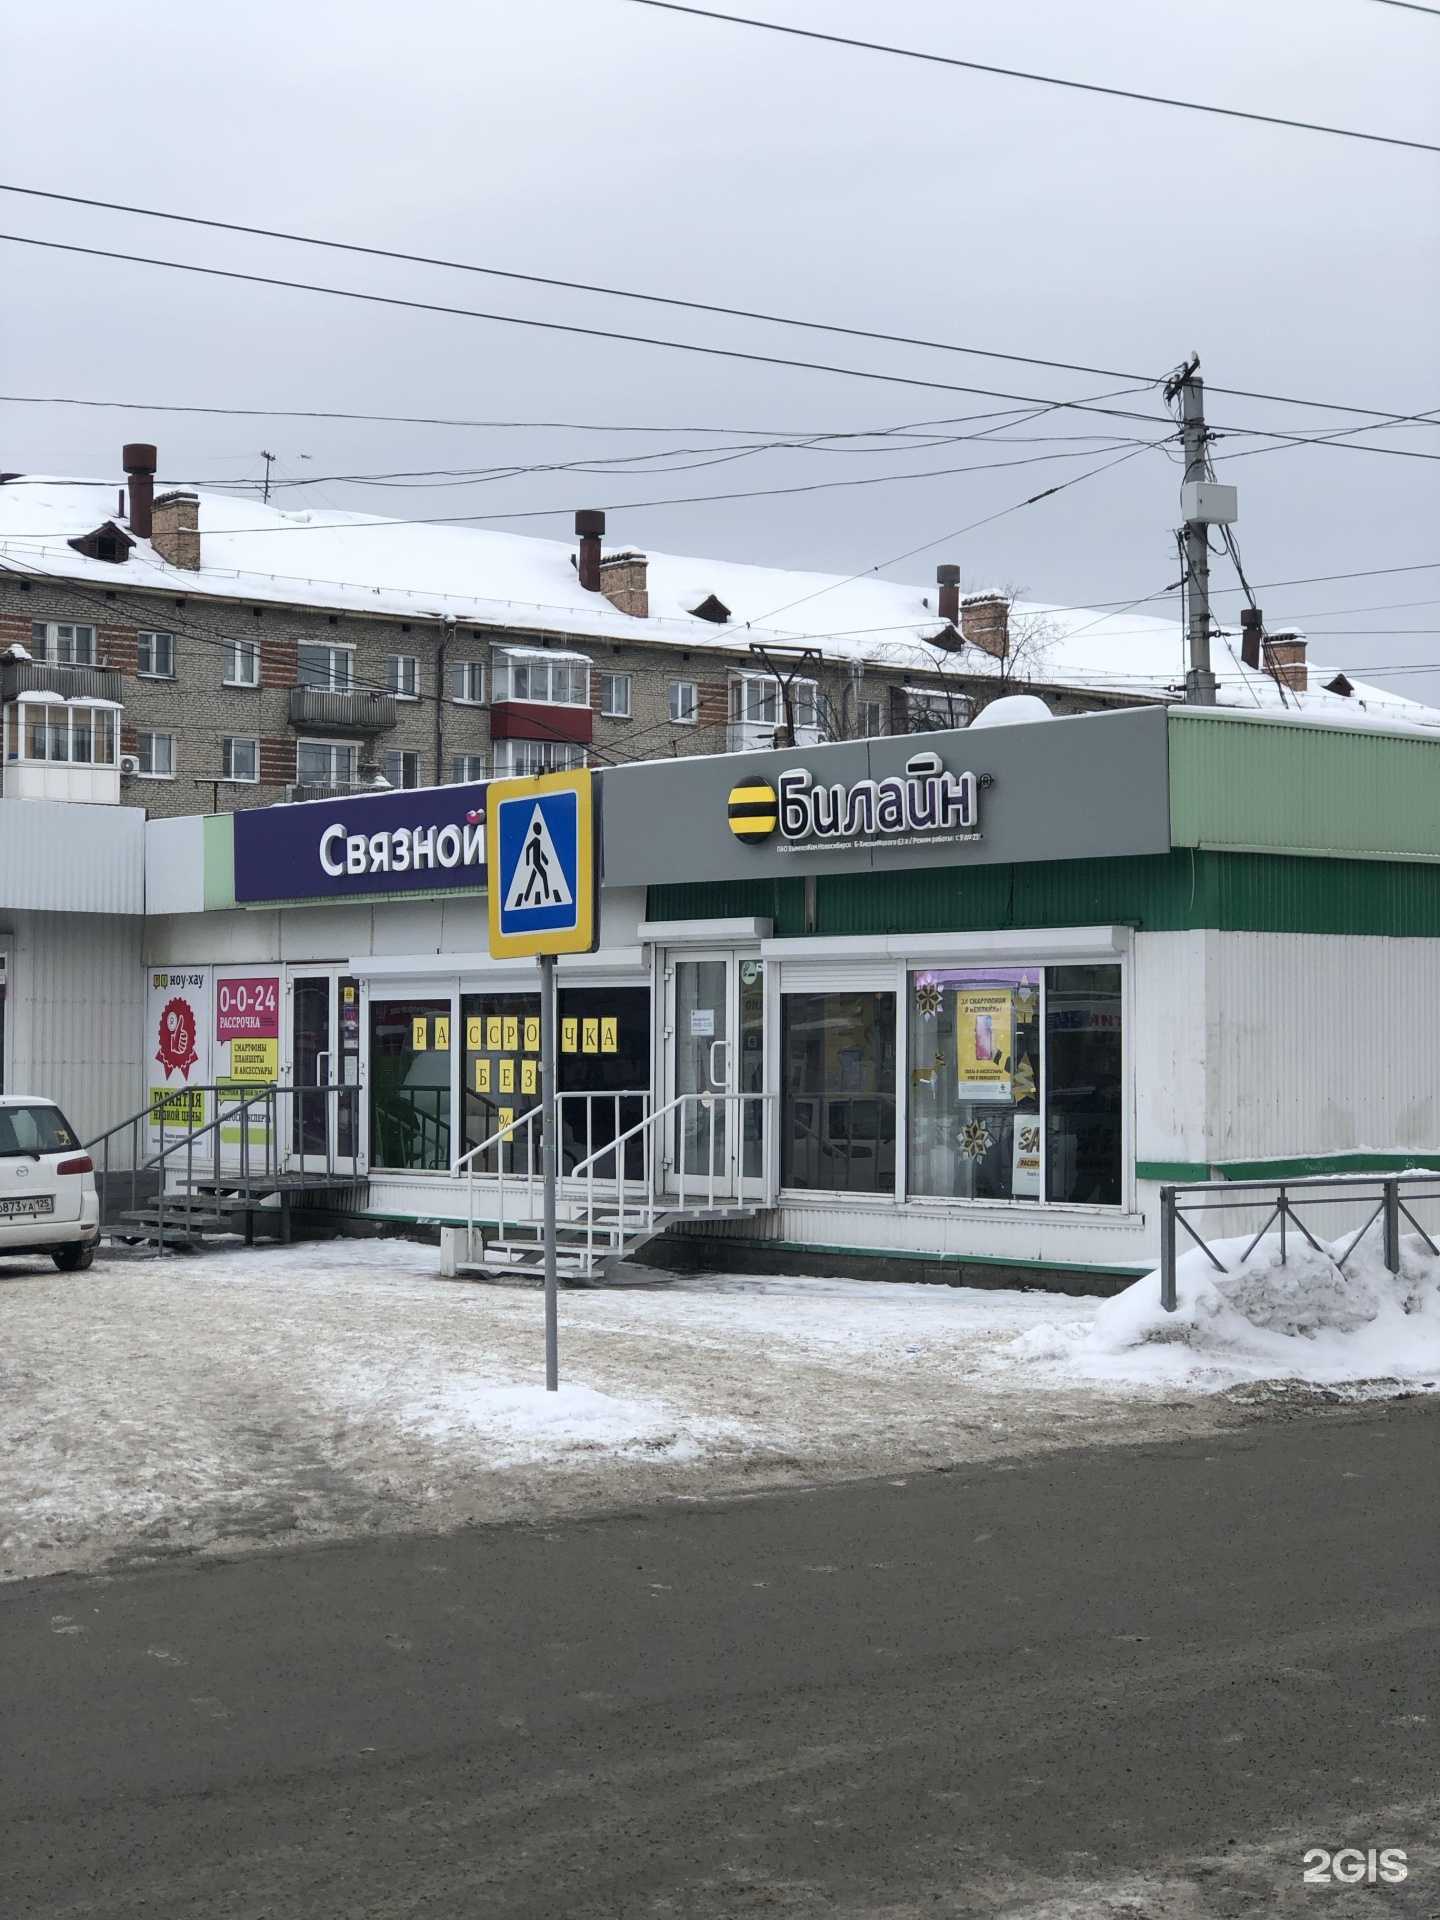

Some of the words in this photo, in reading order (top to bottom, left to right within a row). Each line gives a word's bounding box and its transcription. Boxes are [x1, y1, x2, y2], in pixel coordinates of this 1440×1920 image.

[220, 985, 276, 1013] 0-0-24
[220, 1016, 261, 1030] РАССРОЧКА
[416, 1023, 615, 1047] РАССРОЧКА
[233, 1043, 267, 1052] СМАРТФОНЫ
[233, 1055, 265, 1064] ПЛАНШЕТЫ
[240, 1066, 273, 1075] АКСЕССУАРЫ
[478, 1067, 533, 1088] БЕЗ
